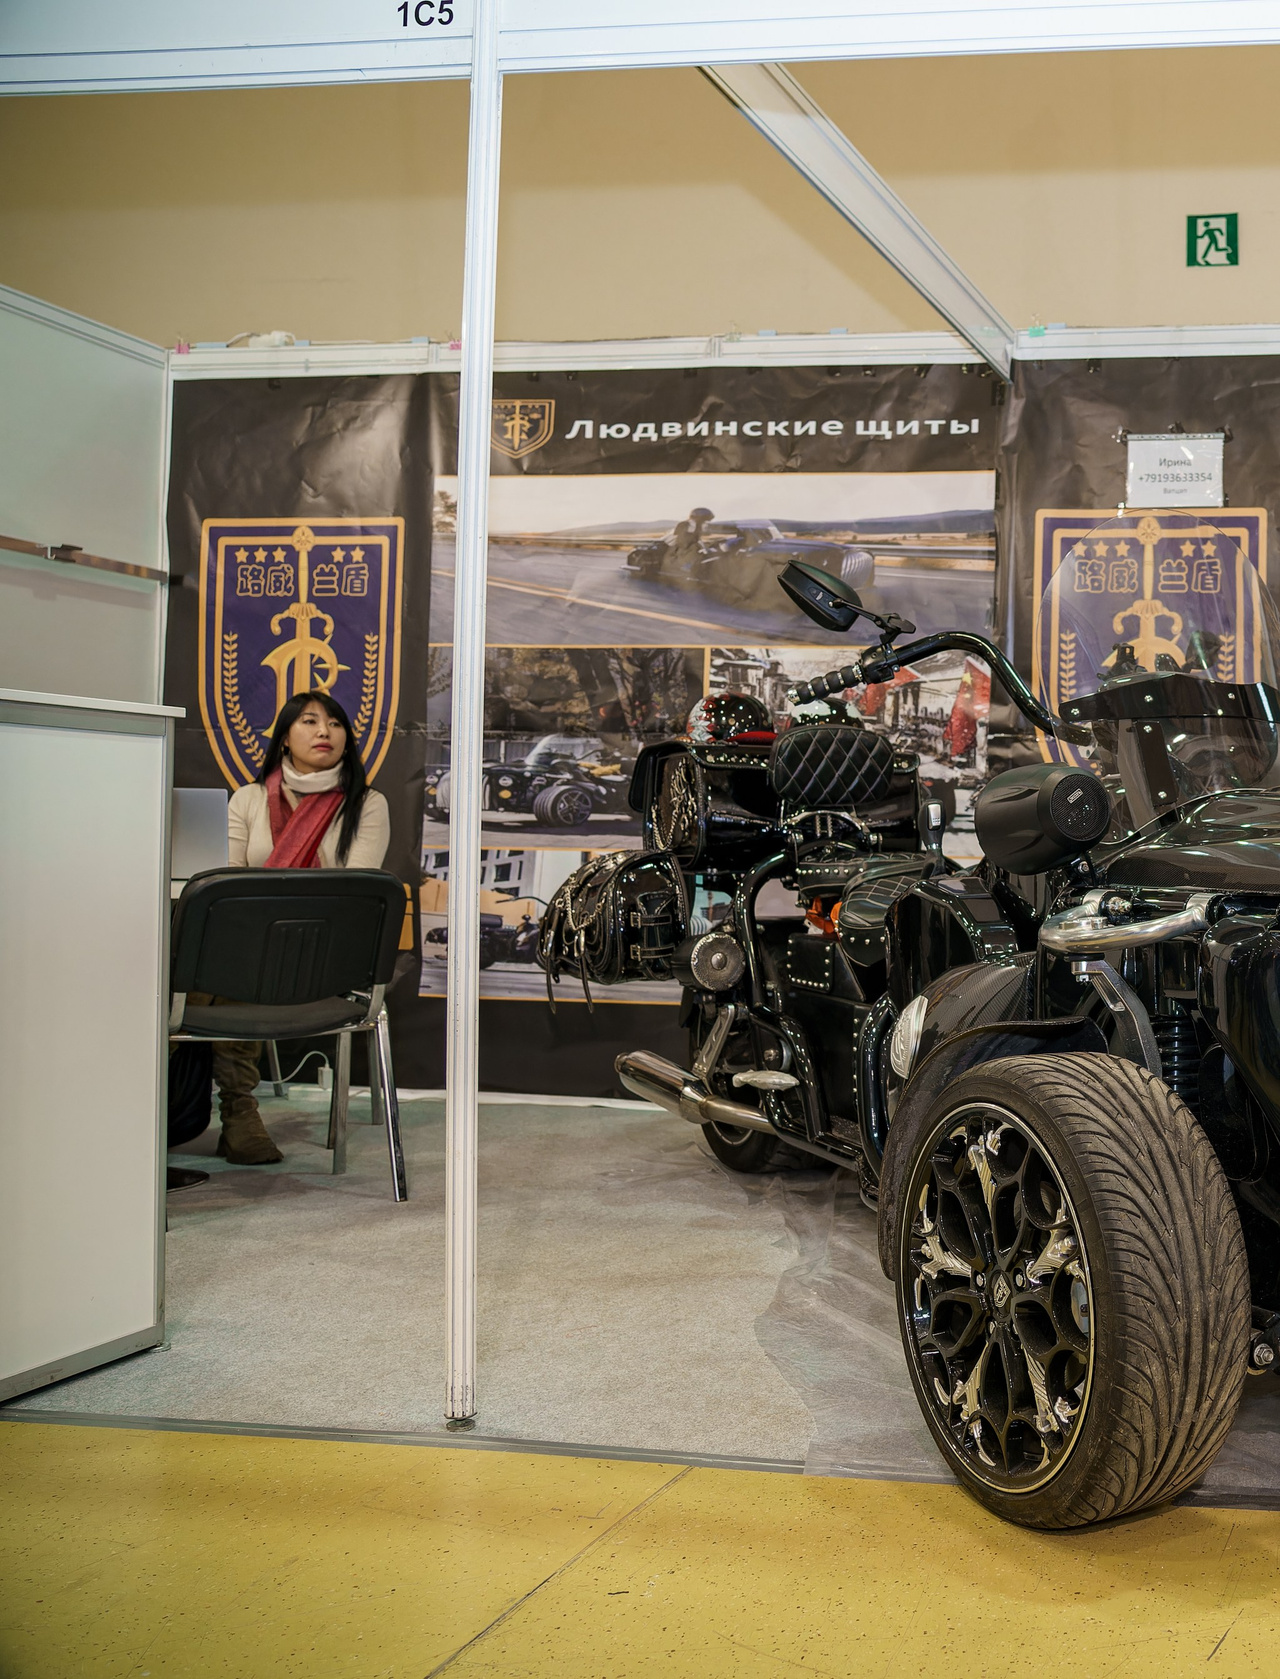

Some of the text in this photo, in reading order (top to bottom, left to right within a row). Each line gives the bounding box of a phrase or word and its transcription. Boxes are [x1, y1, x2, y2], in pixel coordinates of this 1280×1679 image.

[397, 0, 454, 27] 1C5
[565, 418, 980, 442] Людвинские щиты
[1159, 457, 1193, 470] Ирина
[1138, 472, 1213, 484] +79193633354
[1162, 487, 1188, 495] Ватцап
[236, 563, 370, 598] 路威 兰盾
[1074, 559, 1223, 594] 路威 兰盾
